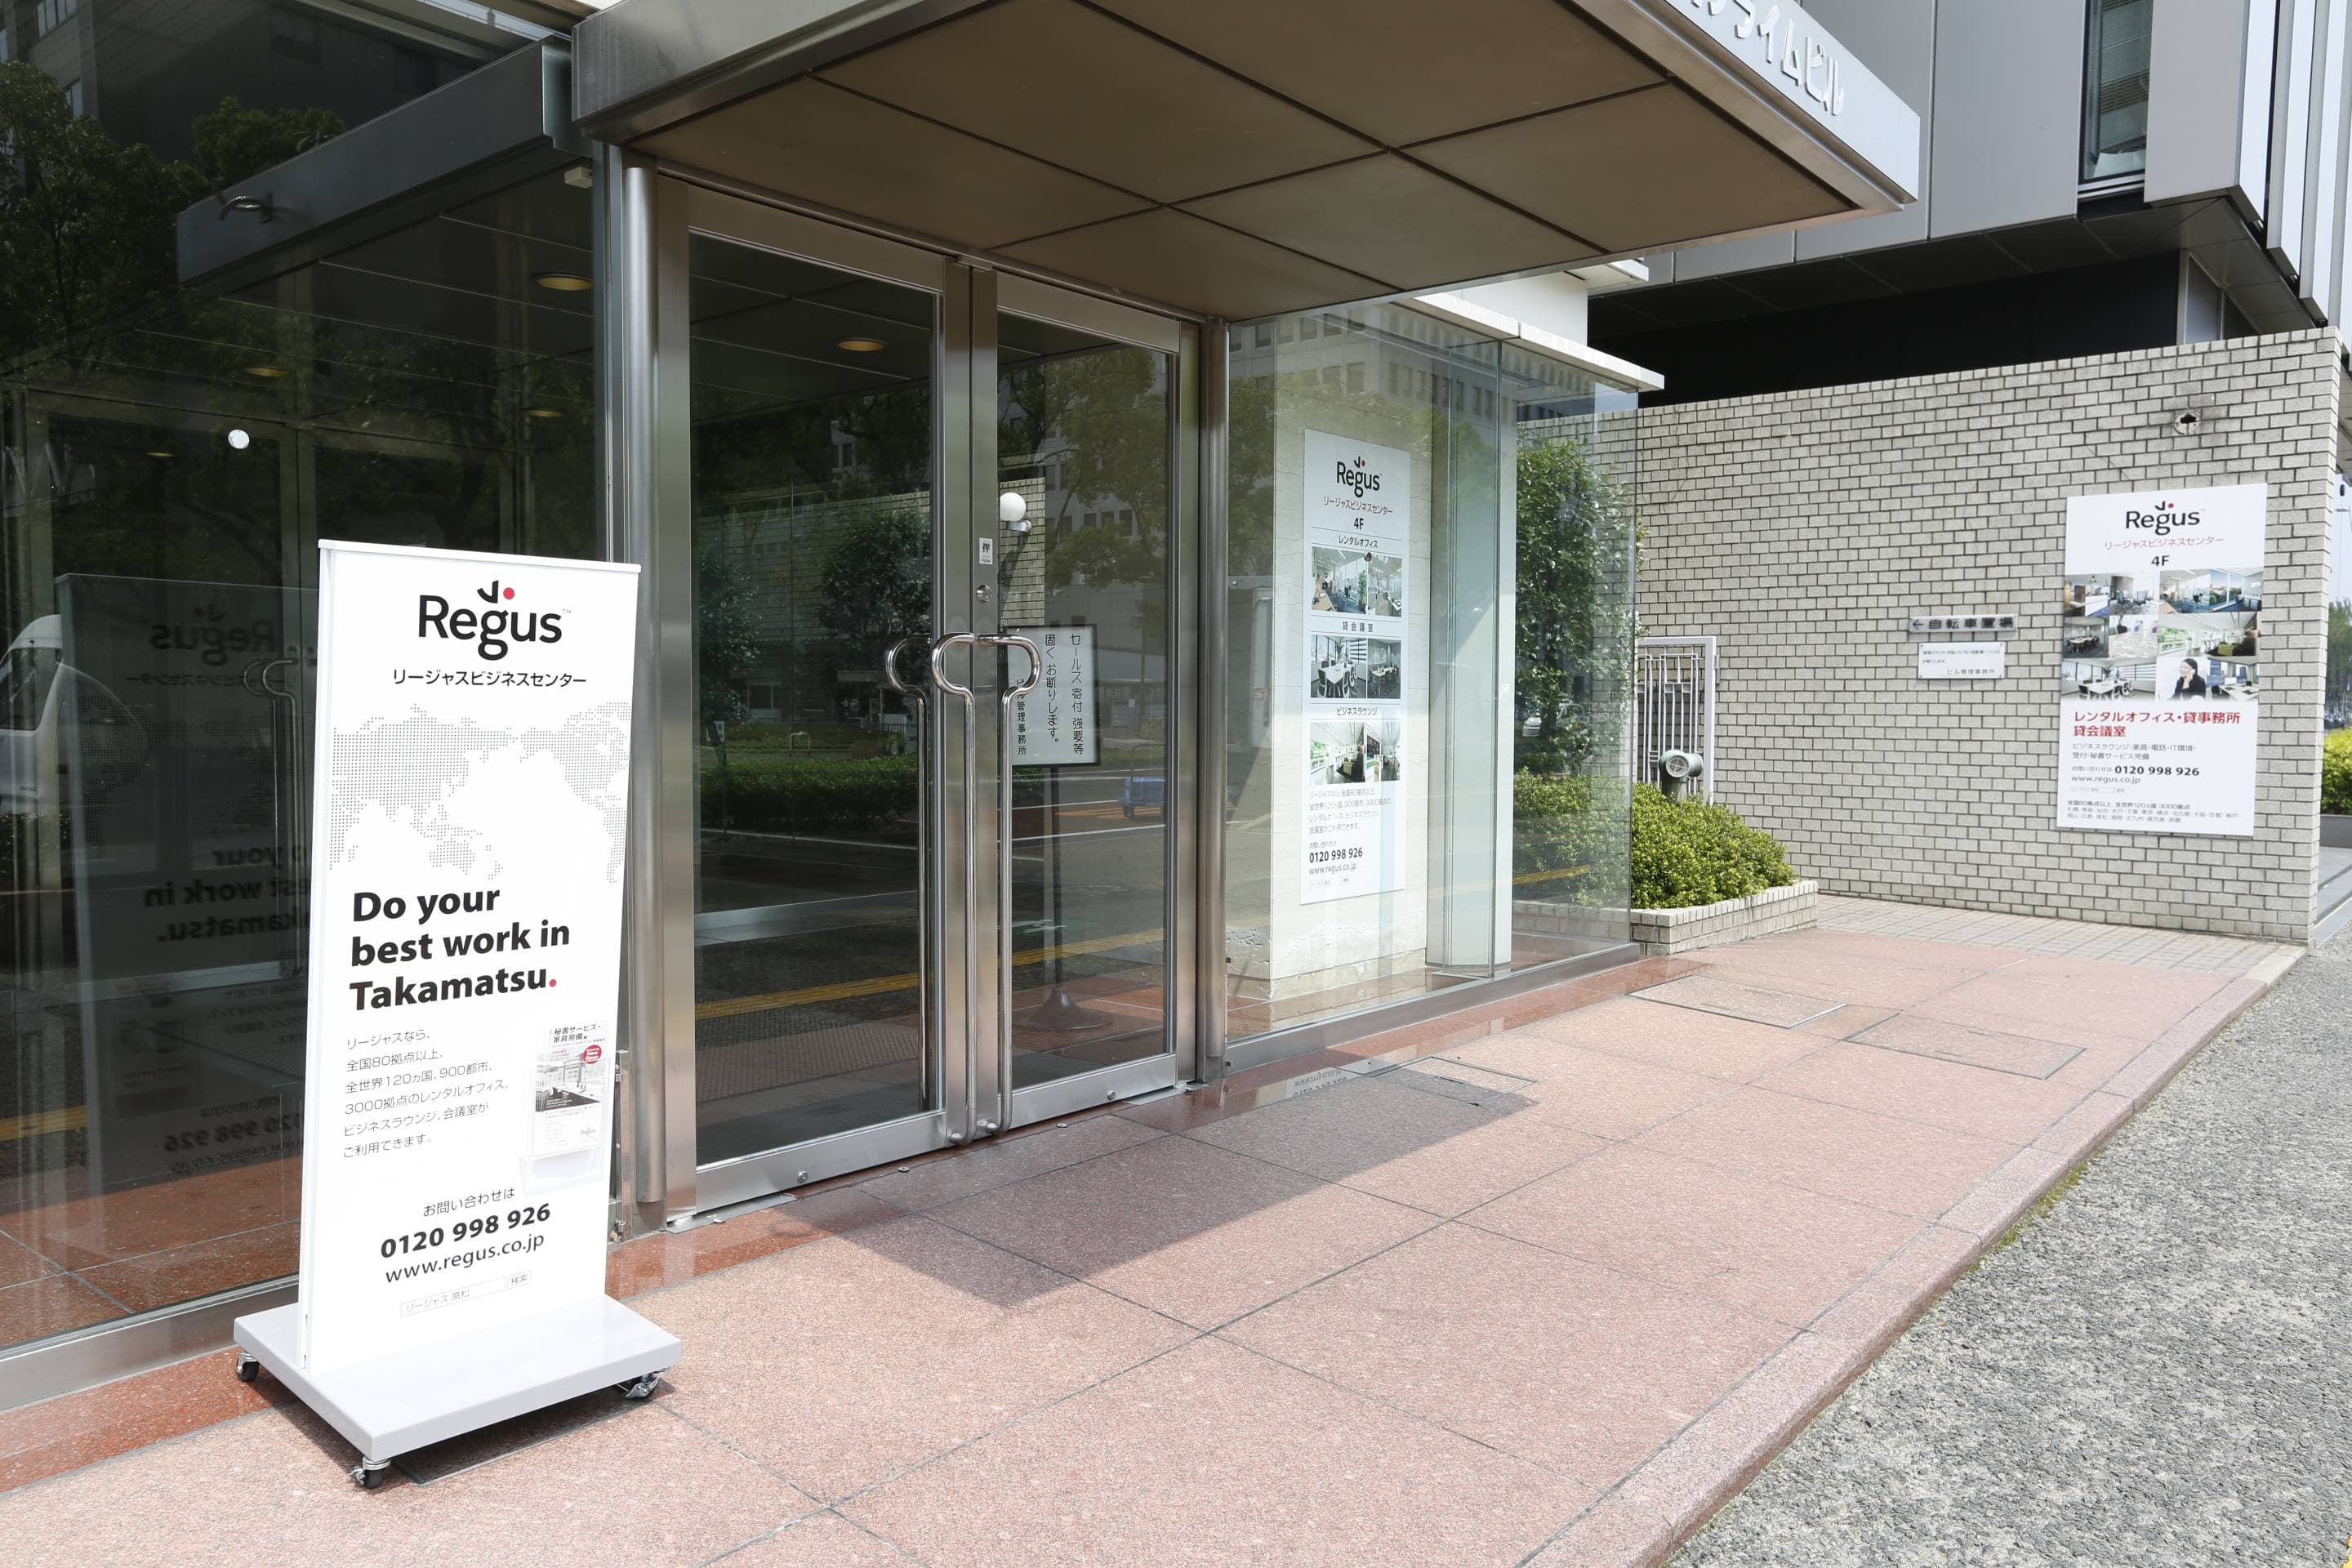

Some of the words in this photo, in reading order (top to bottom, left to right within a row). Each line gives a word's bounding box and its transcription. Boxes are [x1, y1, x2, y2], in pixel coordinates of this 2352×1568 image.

[1689, 0, 1845, 116] ライムビル
[1336, 461, 1380, 498] Regus
[1324, 496, 1393, 515] リージャスビジネスセンター
[1353, 518, 1365, 530] 4F
[2126, 510, 2201, 536] Regus
[1339, 535, 1379, 549] レンタルオフィス
[2105, 536, 2225, 550] リージャスビジネスセンター
[2151, 555, 2170, 567] 4F
[417, 594, 563, 662] Regus
[393, 668, 587, 688] リージャスビジネスセンター
[1336, 706, 1378, 716] ビジネスラウンジ
[2074, 711, 2241, 724] レンタルオフィス・貸事務所
[2074, 725, 2127, 737] 貸会議室
[2071, 776, 2140, 784] www.regus.co.jp
[2114, 765, 2145, 774] 0120
[2148, 766, 2172, 775] 998
[2176, 767, 2200, 777] 926
[1309, 851, 1330, 863] 0120
[1331, 849, 1347, 861] 998
[1348, 847, 1363, 859] 926
[1309, 863, 1356, 875] www.regus.co.jp
[354, 891, 406, 923] Do
[416, 889, 501, 925] your
[351, 933, 433, 967] best
[443, 922, 531, 958] work
[540, 919, 570, 948] in
[349, 968, 558, 1011] Takamatsu.
[347, 1029, 430, 1050] リージャスなら、
[346, 1048, 443, 1072] 全国80拠点以上、
[345, 1079, 509, 1115] 3000拠点のレンタルオフィス、
[344, 1101, 489, 1137] ビジネスラウンジ、会議室が
[343, 1134, 432, 1158] ご利用できます。
[423, 1187, 515, 1217] お問い合わせは
[381, 1227, 444, 1258] 0120
[452, 1214, 499, 1242] 998
[507, 1202, 551, 1229] 926
[385, 1233, 545, 1283] www.regus.co.jp
